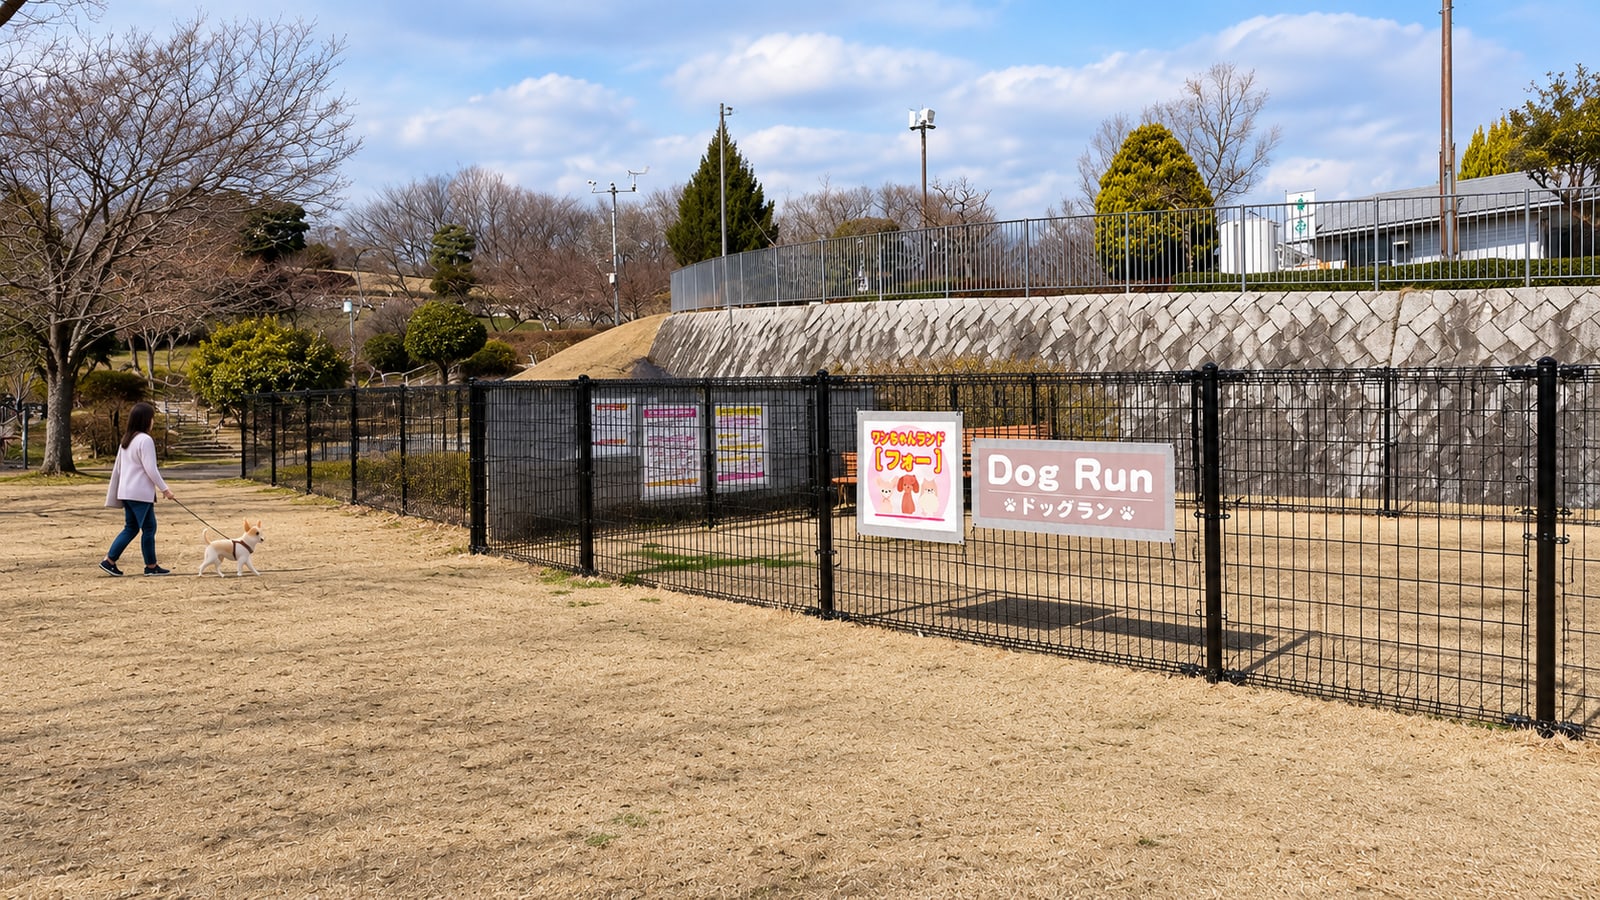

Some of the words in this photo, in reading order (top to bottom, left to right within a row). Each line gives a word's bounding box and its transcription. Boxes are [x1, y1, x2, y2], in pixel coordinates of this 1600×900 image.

[871, 430, 945, 447] ワンちゃんランド
[988, 454, 1060, 492] Dog
[1074, 457, 1153, 494] Run
[1022, 497, 1113, 521] ドッグラン
